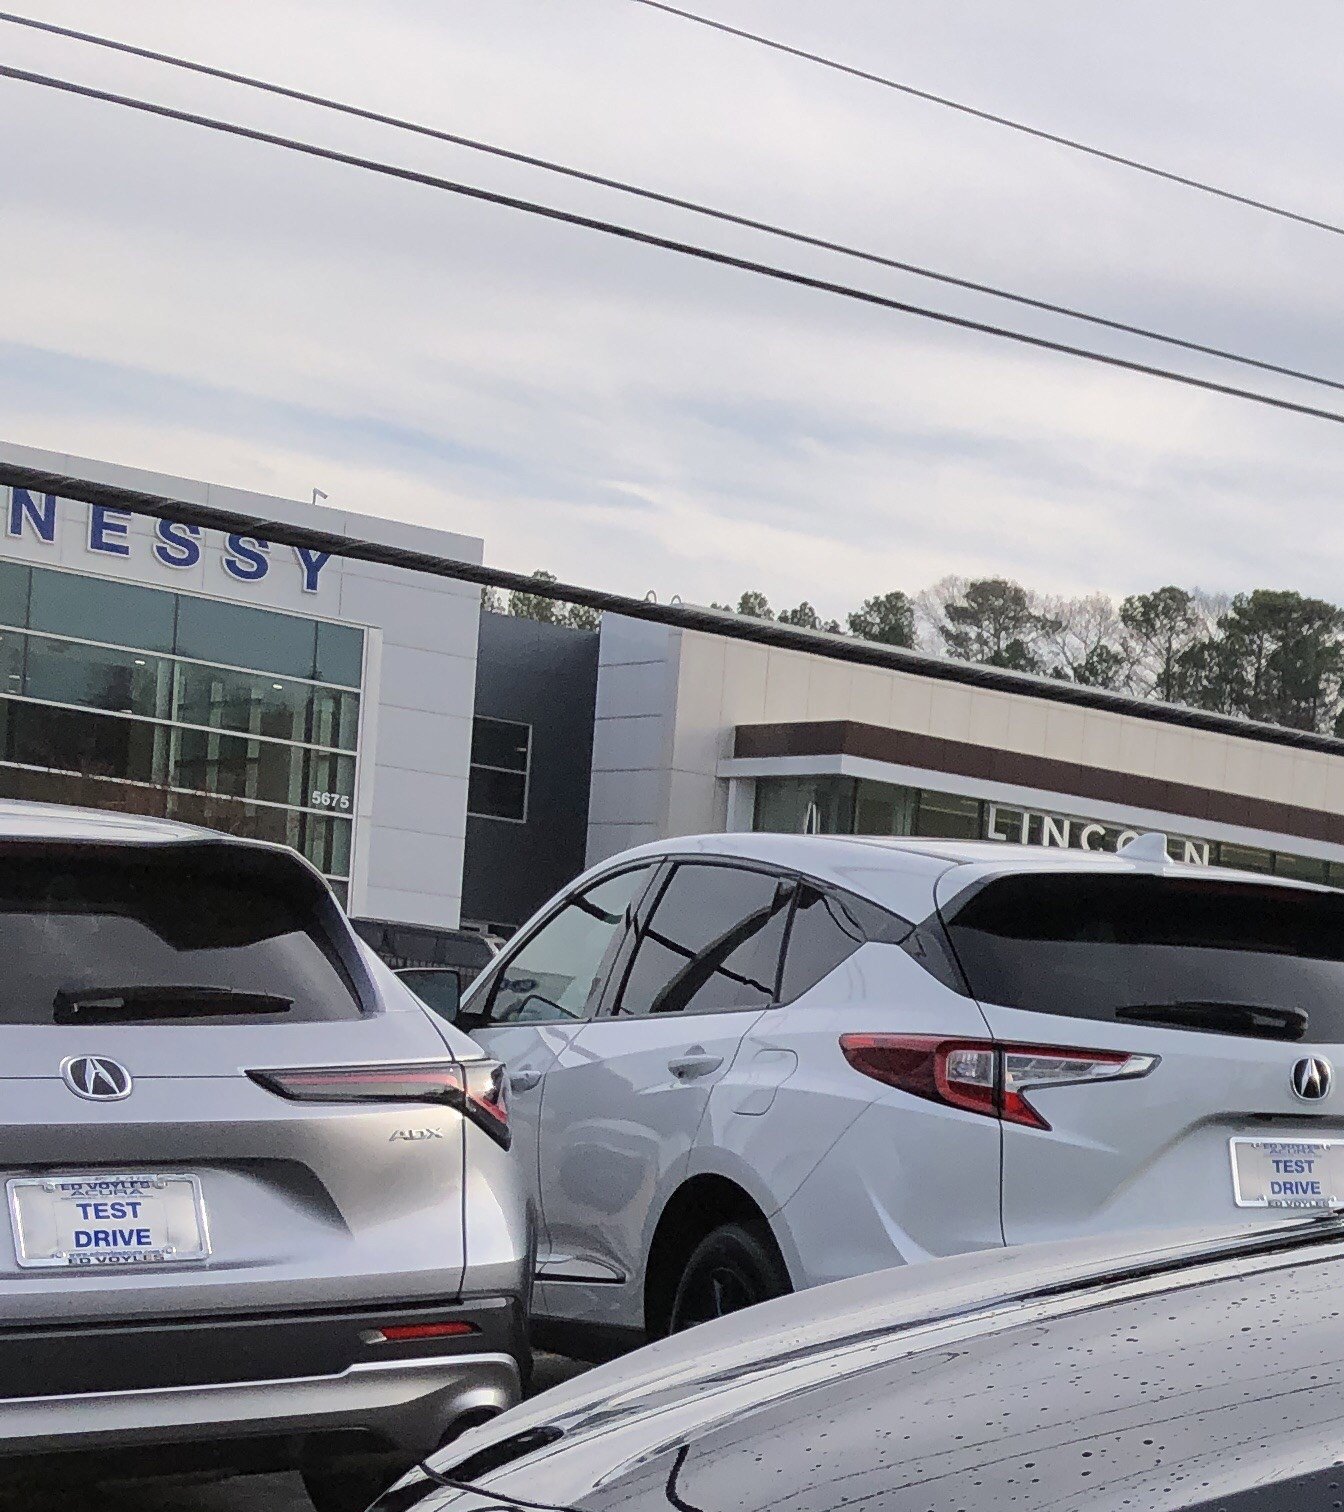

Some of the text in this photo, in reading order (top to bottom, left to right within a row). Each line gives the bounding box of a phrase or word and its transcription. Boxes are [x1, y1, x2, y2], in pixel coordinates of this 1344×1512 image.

[7, 486, 332, 593] NESSY
[311, 790, 350, 809] 5675
[987, 802, 1210, 867] LINCON
[1271, 1159, 1315, 1174] TEST
[1270, 1180, 1322, 1195] DRIVE
[75, 1201, 142, 1221] TEST
[74, 1228, 152, 1248] DRIVE
